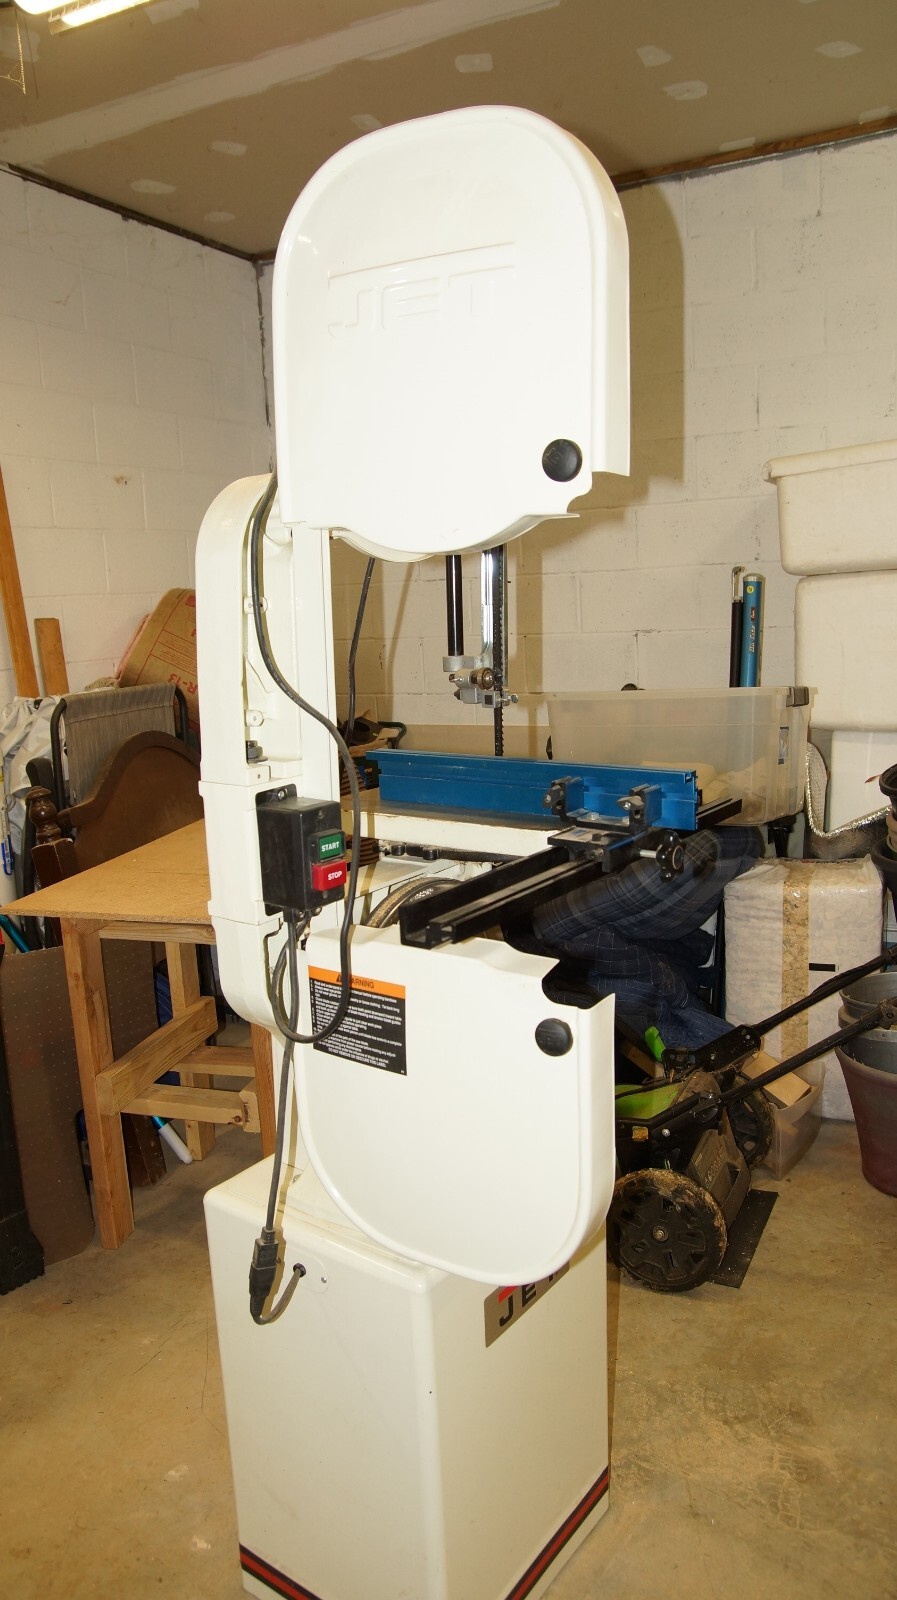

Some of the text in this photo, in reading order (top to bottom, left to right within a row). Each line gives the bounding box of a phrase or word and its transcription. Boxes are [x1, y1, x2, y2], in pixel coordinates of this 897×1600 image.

[328, 265, 515, 338] JET
[168, 673, 198, 694] R-13
[321, 841, 340, 852] START
[328, 870, 342, 880] STOP
[351, 976, 374, 989] ARNING
[499, 1272, 554, 1327] JE
